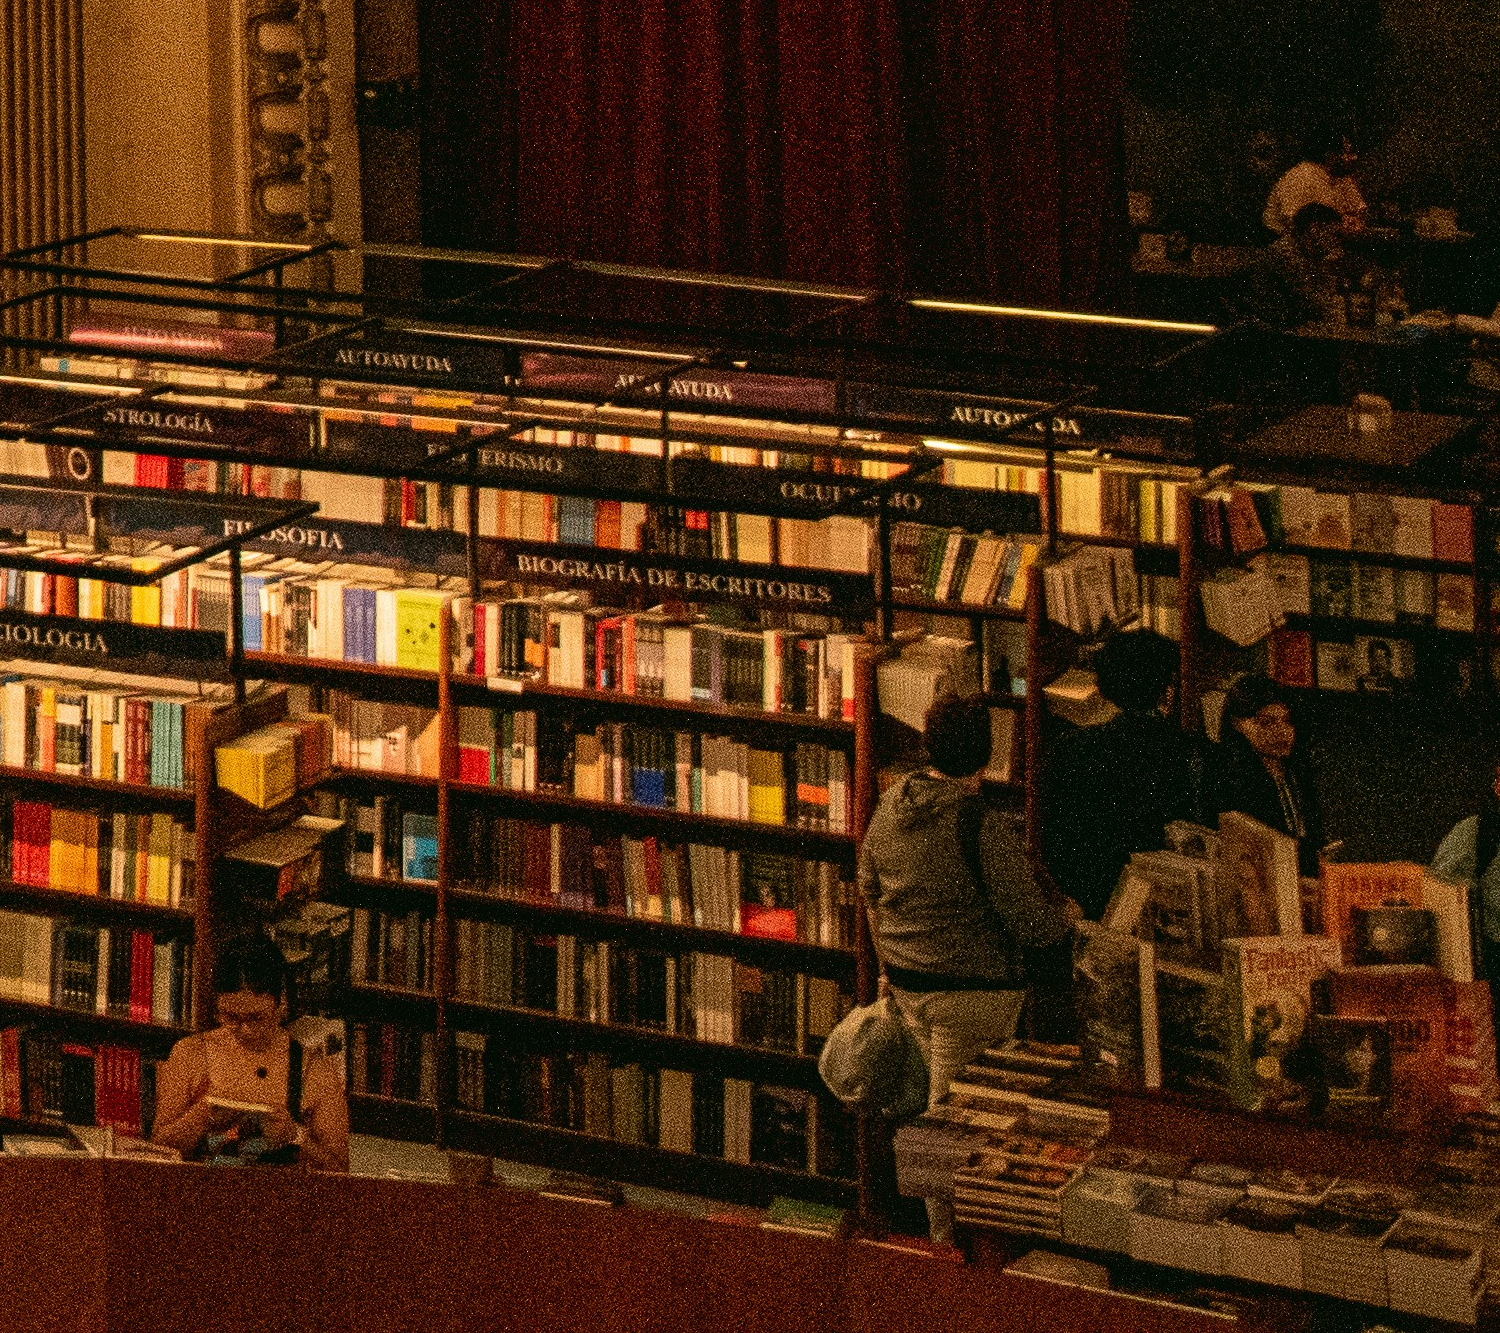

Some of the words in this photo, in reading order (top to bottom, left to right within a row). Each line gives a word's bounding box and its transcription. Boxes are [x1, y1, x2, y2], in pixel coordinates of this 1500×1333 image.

[334, 348, 454, 374] AUTOAYUDA
[516, 554, 643, 584] BIOGRAFÍA
[646, 567, 680, 589] DE
[684, 572, 833, 604] ESCRITORES
